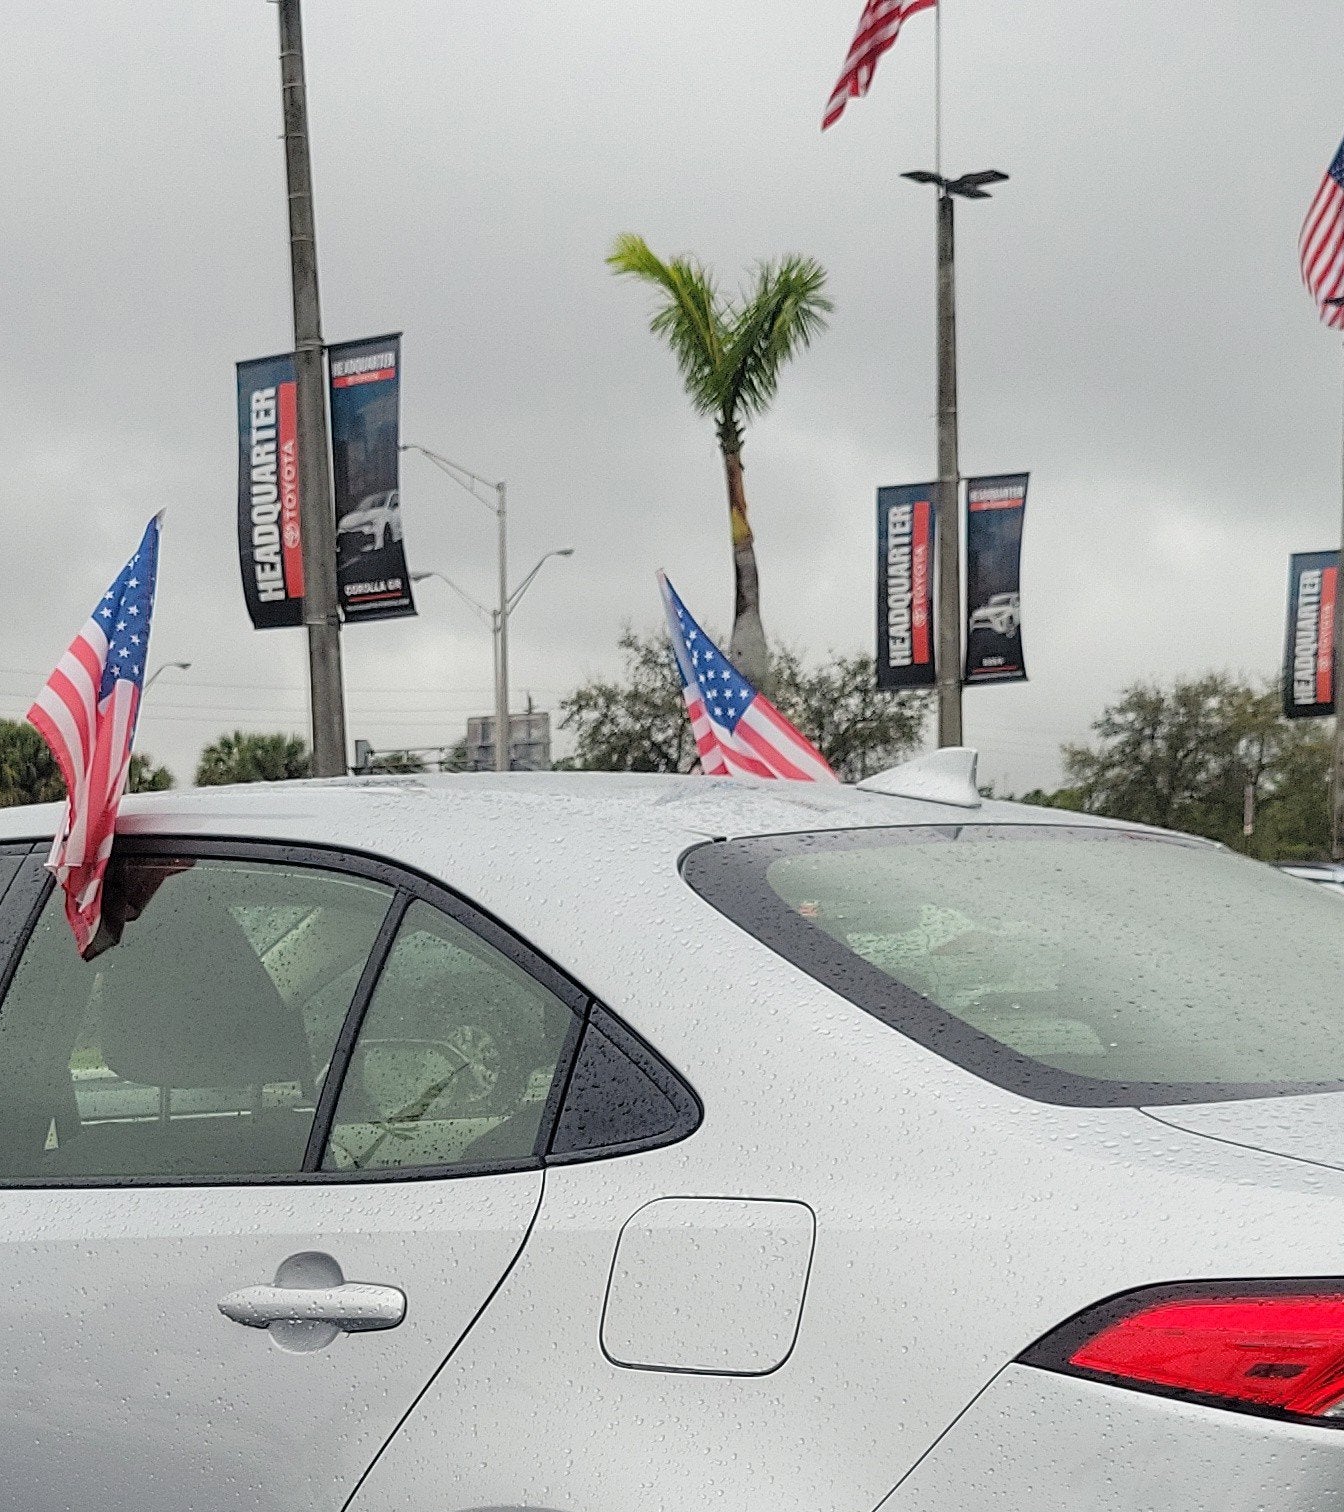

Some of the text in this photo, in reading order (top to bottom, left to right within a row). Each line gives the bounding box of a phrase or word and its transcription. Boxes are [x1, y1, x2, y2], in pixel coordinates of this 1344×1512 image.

[251, 386, 287, 603] HEADQUARTER
[282, 438, 298, 520] TOYOTA
[887, 504, 914, 668] HEADQUARTER
[1293, 569, 1321, 705] HEADQUARTER
